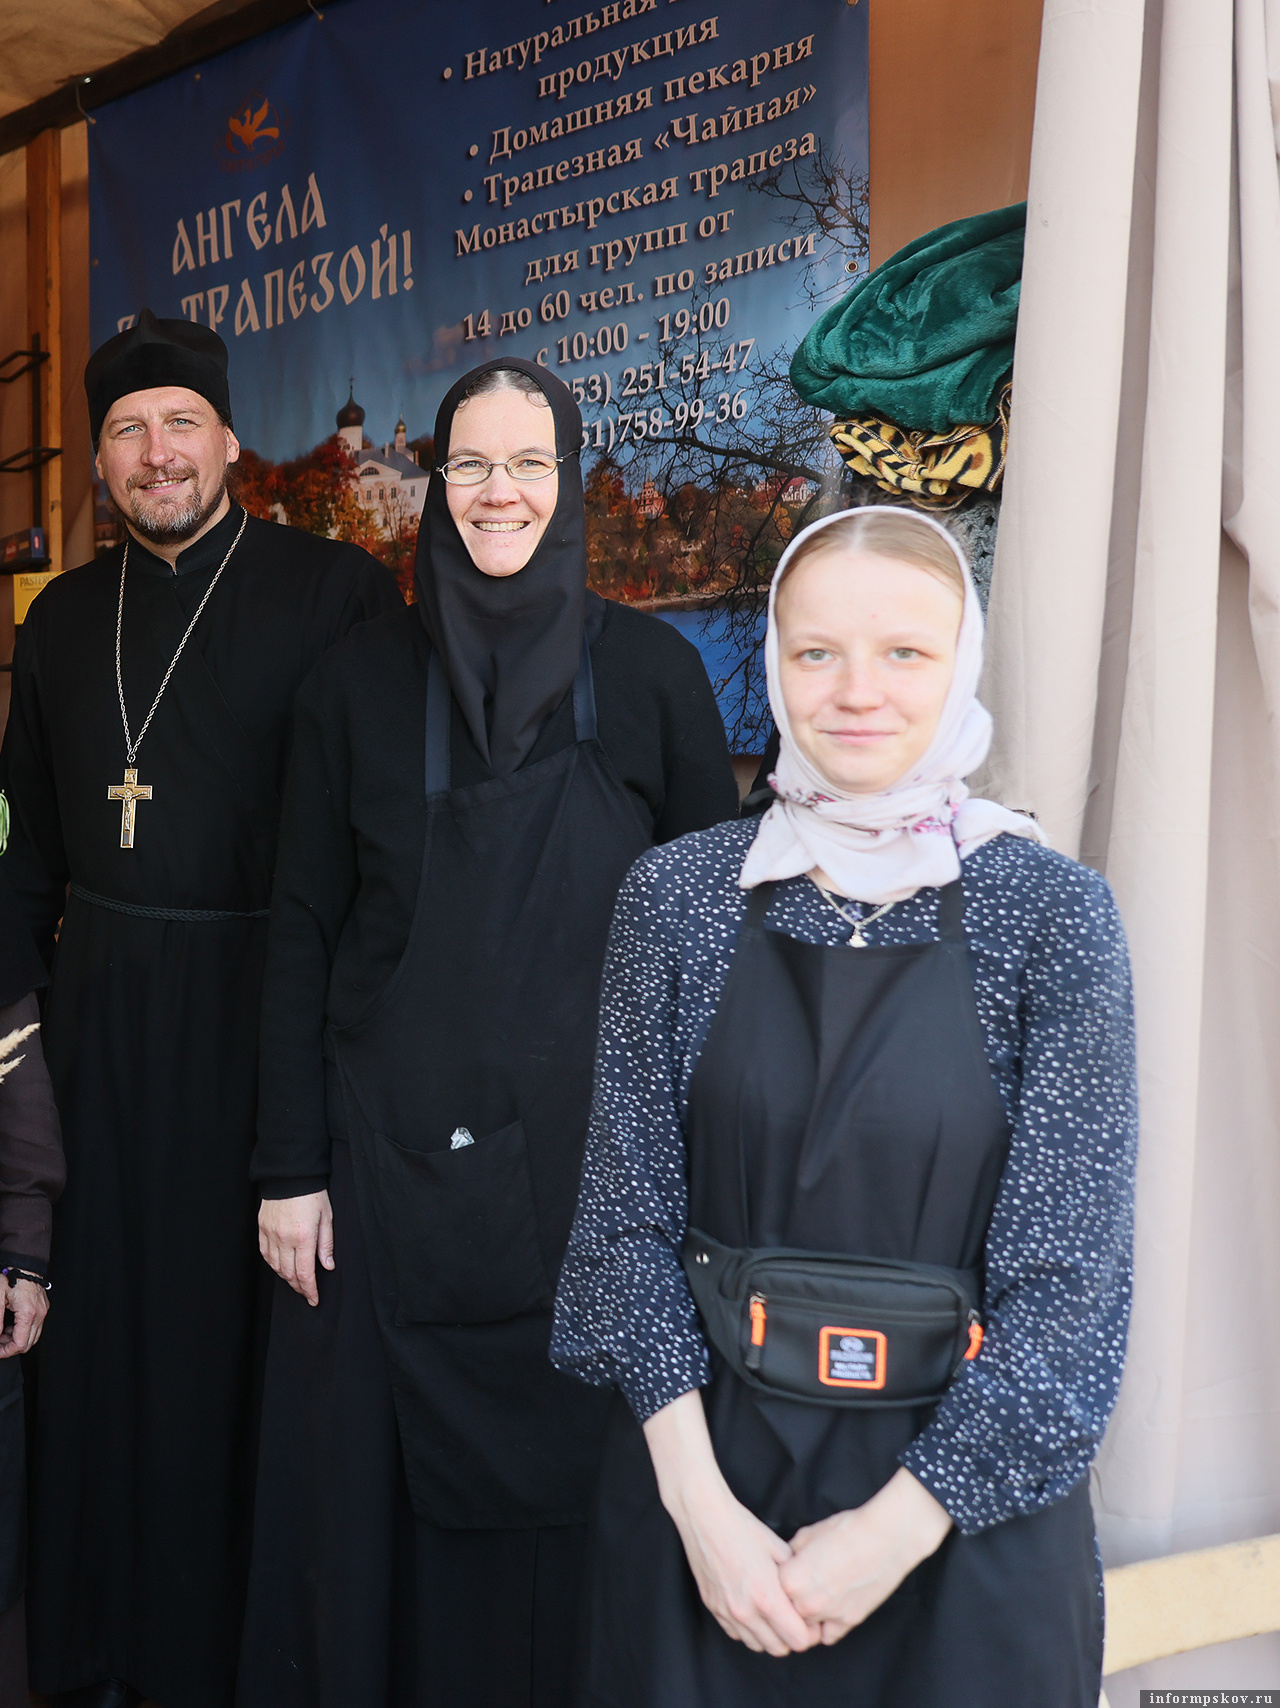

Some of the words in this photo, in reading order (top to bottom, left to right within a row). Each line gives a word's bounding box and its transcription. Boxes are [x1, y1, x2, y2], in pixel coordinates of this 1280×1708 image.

[464, 0, 657, 80] Натуральная
[538, 16, 720, 100] продукция
[489, 86, 654, 165] Домашняя
[664, 34, 815, 102] пекарня
[483, 137, 644, 207] Трапезная
[654, 83, 818, 150] «Чайная»
[172, 172, 327, 275] АНГЕЛА
[455, 176, 680, 257] Монастырская
[689, 131, 817, 198] трапеза
[463, 309, 492, 341] 14
[500, 307, 532, 336] до
[540, 290, 571, 322] 60
[579, 282, 644, 312] чел.
[654, 269, 695, 297] по
[704, 232, 818, 285] записи
[525, 249, 580, 285] для
[589, 222, 688, 271] групп
[699, 209, 735, 238] от
[536, 347, 549, 367] с
[557, 322, 629, 364] 10:00
[658, 297, 731, 344] 19:00
[562, 371, 612, 408] 53)
[621, 338, 757, 397] 251-54-47
[580, 388, 748, 454] 51)758-99-36
